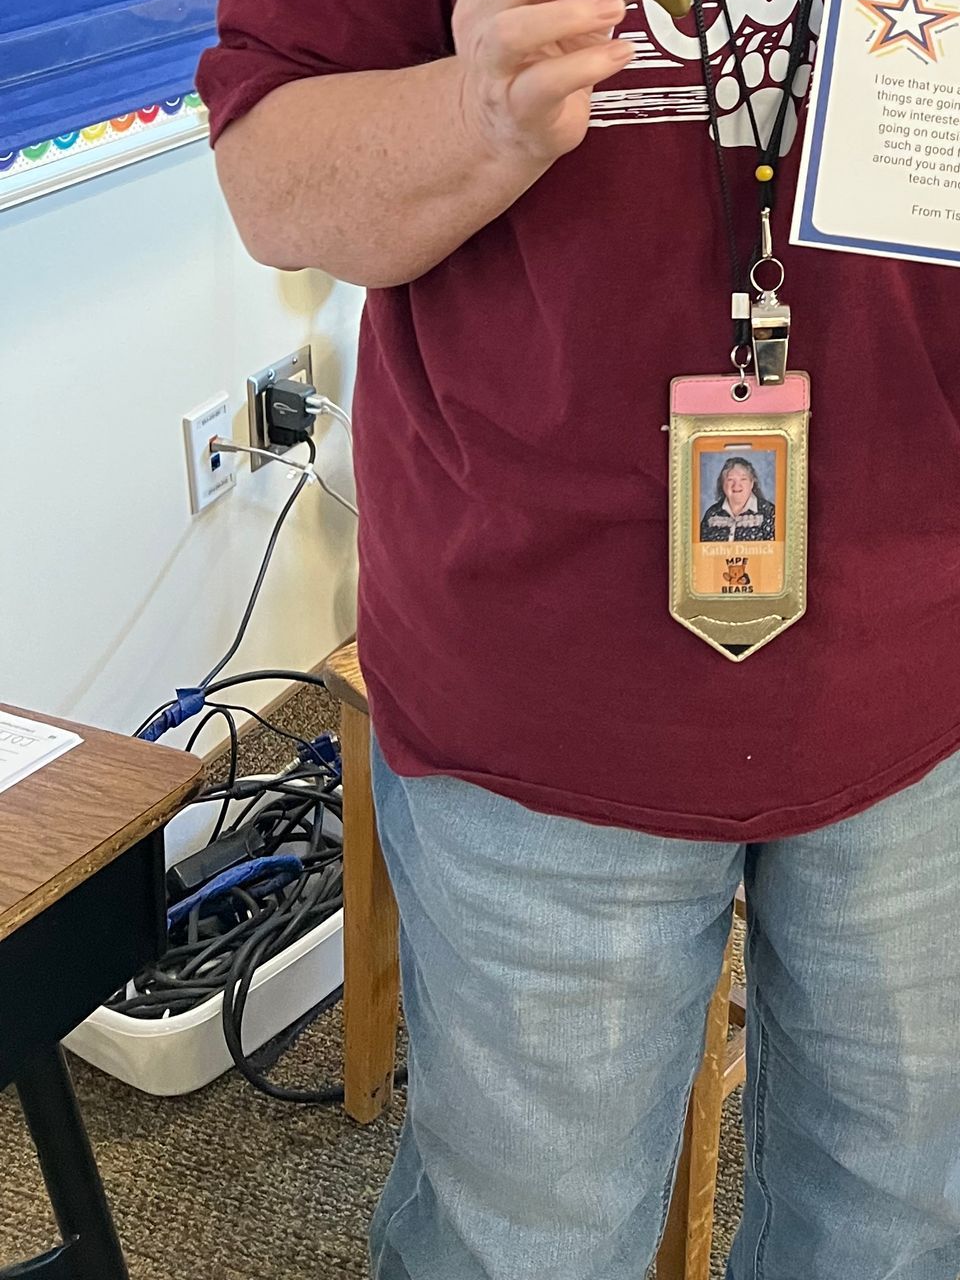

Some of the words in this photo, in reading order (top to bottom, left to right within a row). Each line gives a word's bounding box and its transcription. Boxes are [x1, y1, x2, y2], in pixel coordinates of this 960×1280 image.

[874, 74, 878, 84] I
[881, 74, 905, 86] love
[908, 78, 930, 91] that
[933, 83, 954, 94] you
[877, 90, 912, 105] things
[915, 97, 934, 107] are
[882, 106, 907, 118] how
[878, 123, 910, 138] going
[913, 128, 928, 137] on
[884, 139, 912, 151] such
[914, 144, 922, 152] a
[924, 145, 954, 157] good
[872, 154, 913, 167] around
[914, 159, 936, 171] you
[939, 163, 960, 173] and
[909, 173, 940, 186] teach
[911, 204, 941, 218] From
[702, 544, 733, 557] Kathy
[735, 543, 774, 555] Dimick
[725, 557, 749, 566] MPE
[721, 586, 754, 594] BEARS
